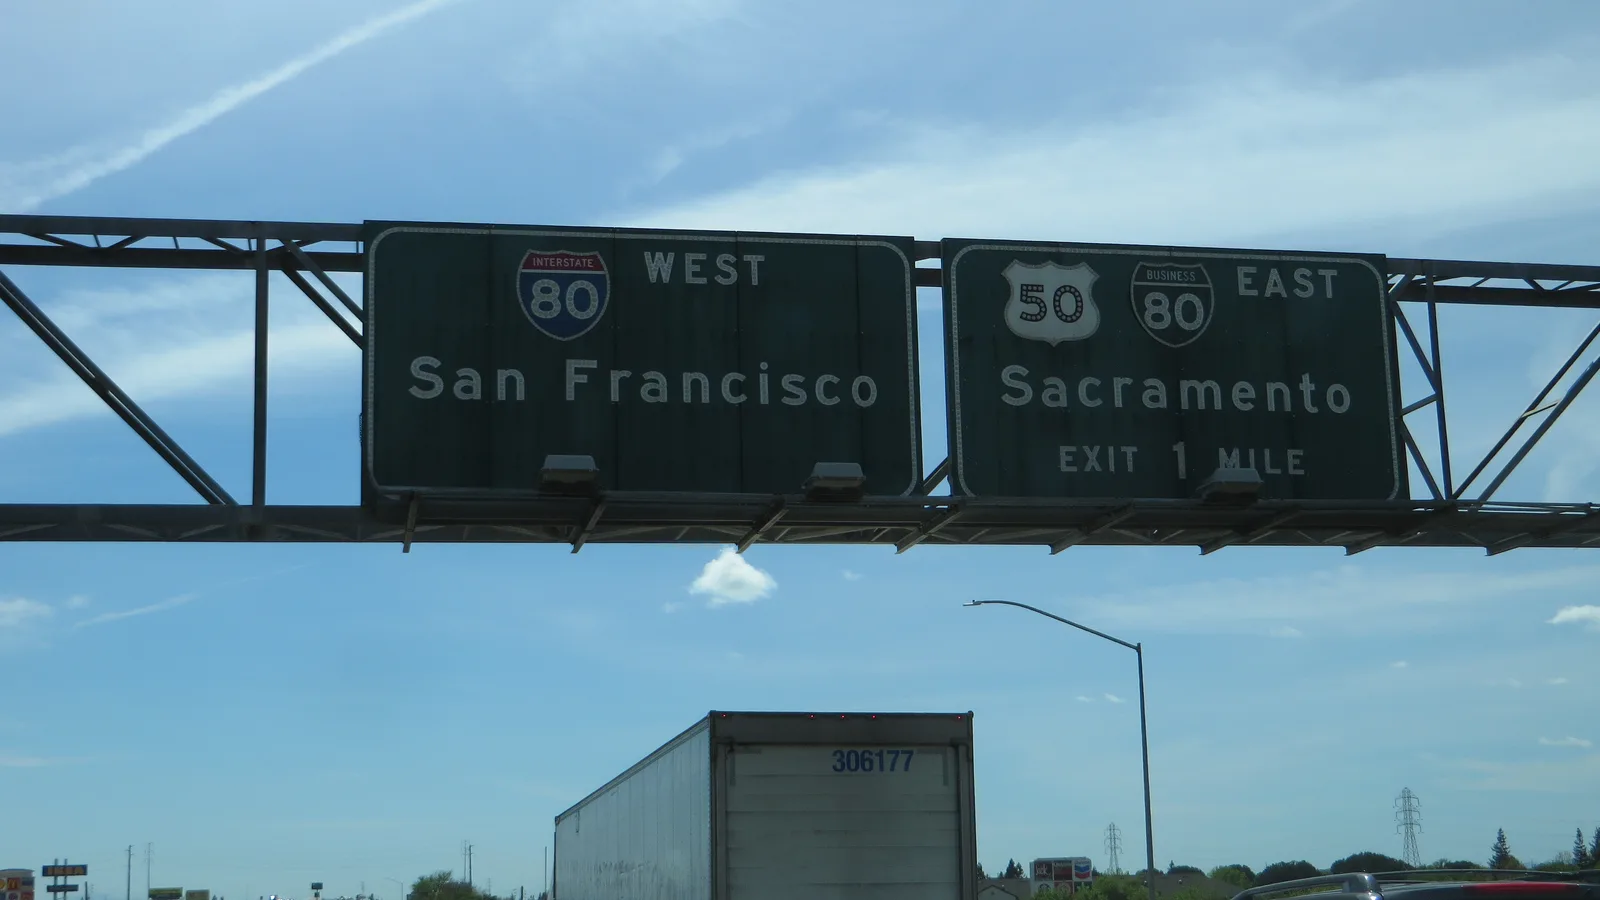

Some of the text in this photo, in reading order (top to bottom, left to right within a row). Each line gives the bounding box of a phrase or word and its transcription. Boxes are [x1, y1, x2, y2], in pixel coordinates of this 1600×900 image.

[532, 257, 594, 269] INTERSTATE
[643, 251, 766, 286] WEST
[1146, 269, 1196, 283] BUSINESS
[1236, 265, 1338, 299] EAST
[530, 278, 599, 320] 80
[1019, 283, 1084, 324] 50
[1143, 291, 1204, 331] 80
[408, 355, 878, 408] San Francisco
[1000, 364, 1351, 414] Sacramento
[1059, 441, 1305, 480] EXIT 1 MILE
[832, 749, 914, 772] 306177
